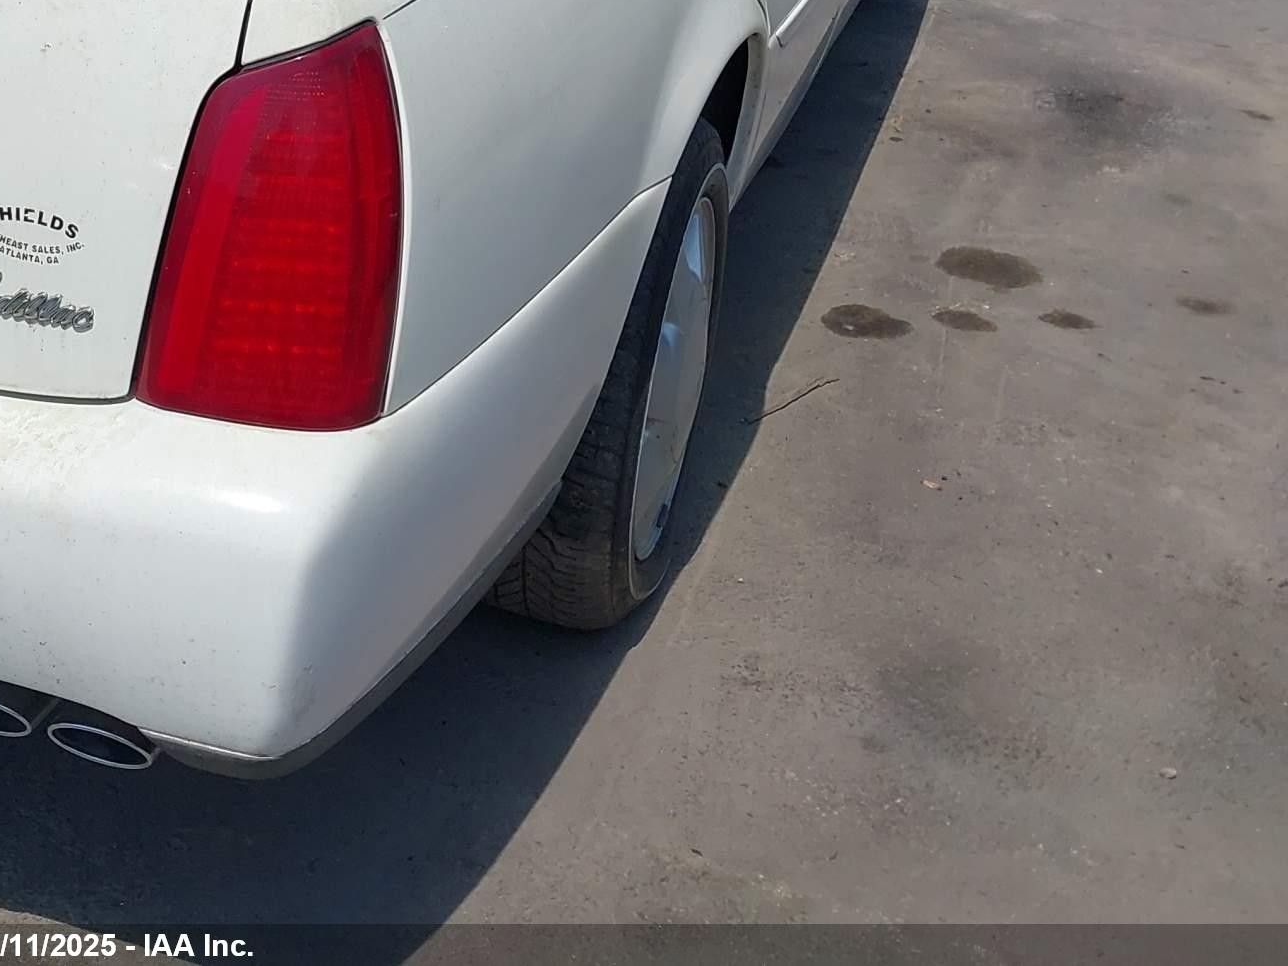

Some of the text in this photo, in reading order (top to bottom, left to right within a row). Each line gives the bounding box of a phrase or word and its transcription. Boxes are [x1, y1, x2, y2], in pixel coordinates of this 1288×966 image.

[31, 244, 64, 255] SALES,
[66, 241, 85, 253] INC.
[46, 255, 59, 265] GA
